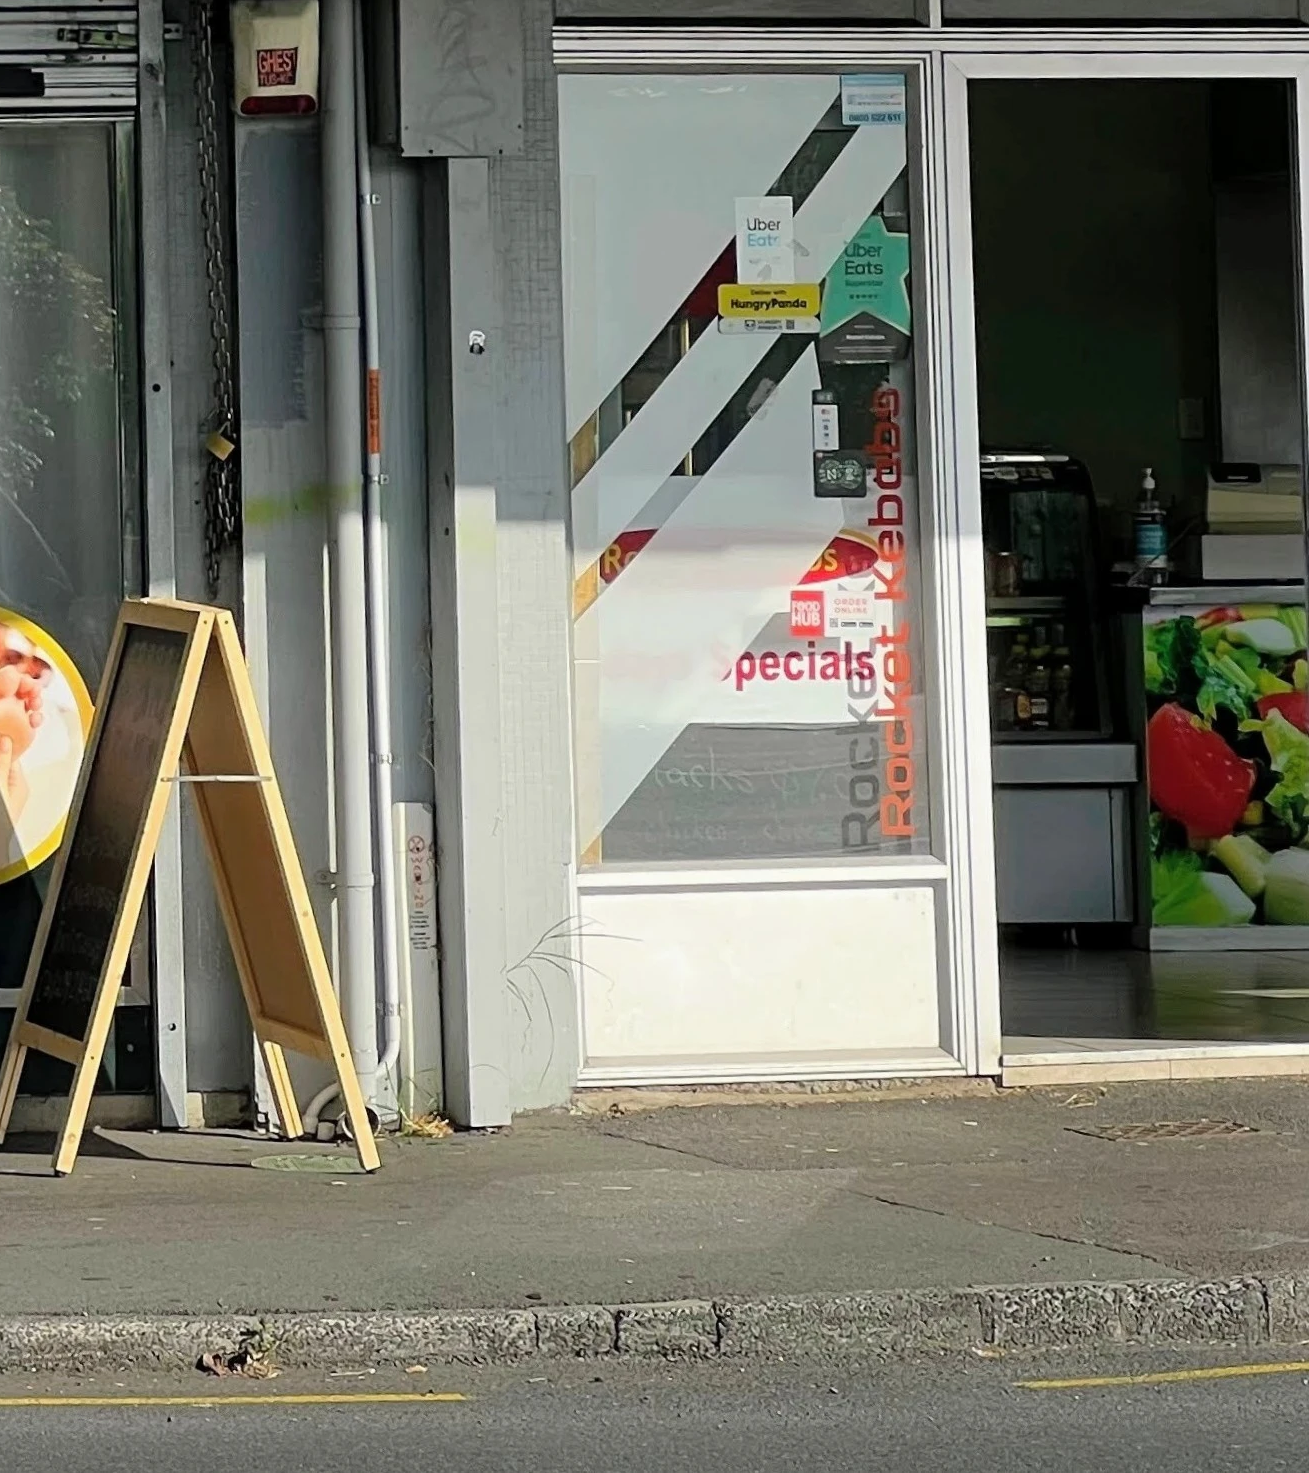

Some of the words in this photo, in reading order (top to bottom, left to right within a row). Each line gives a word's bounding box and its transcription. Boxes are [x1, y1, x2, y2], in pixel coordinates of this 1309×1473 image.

[746, 217, 781, 231] Uber
[844, 243, 883, 258] Uber
[844, 260, 884, 275] Eats
[730, 298, 807, 311] HungryPanda
[791, 600, 821, 613] FOOD
[791, 613, 821, 627] HUB
[873, 622, 917, 837] Rocket
